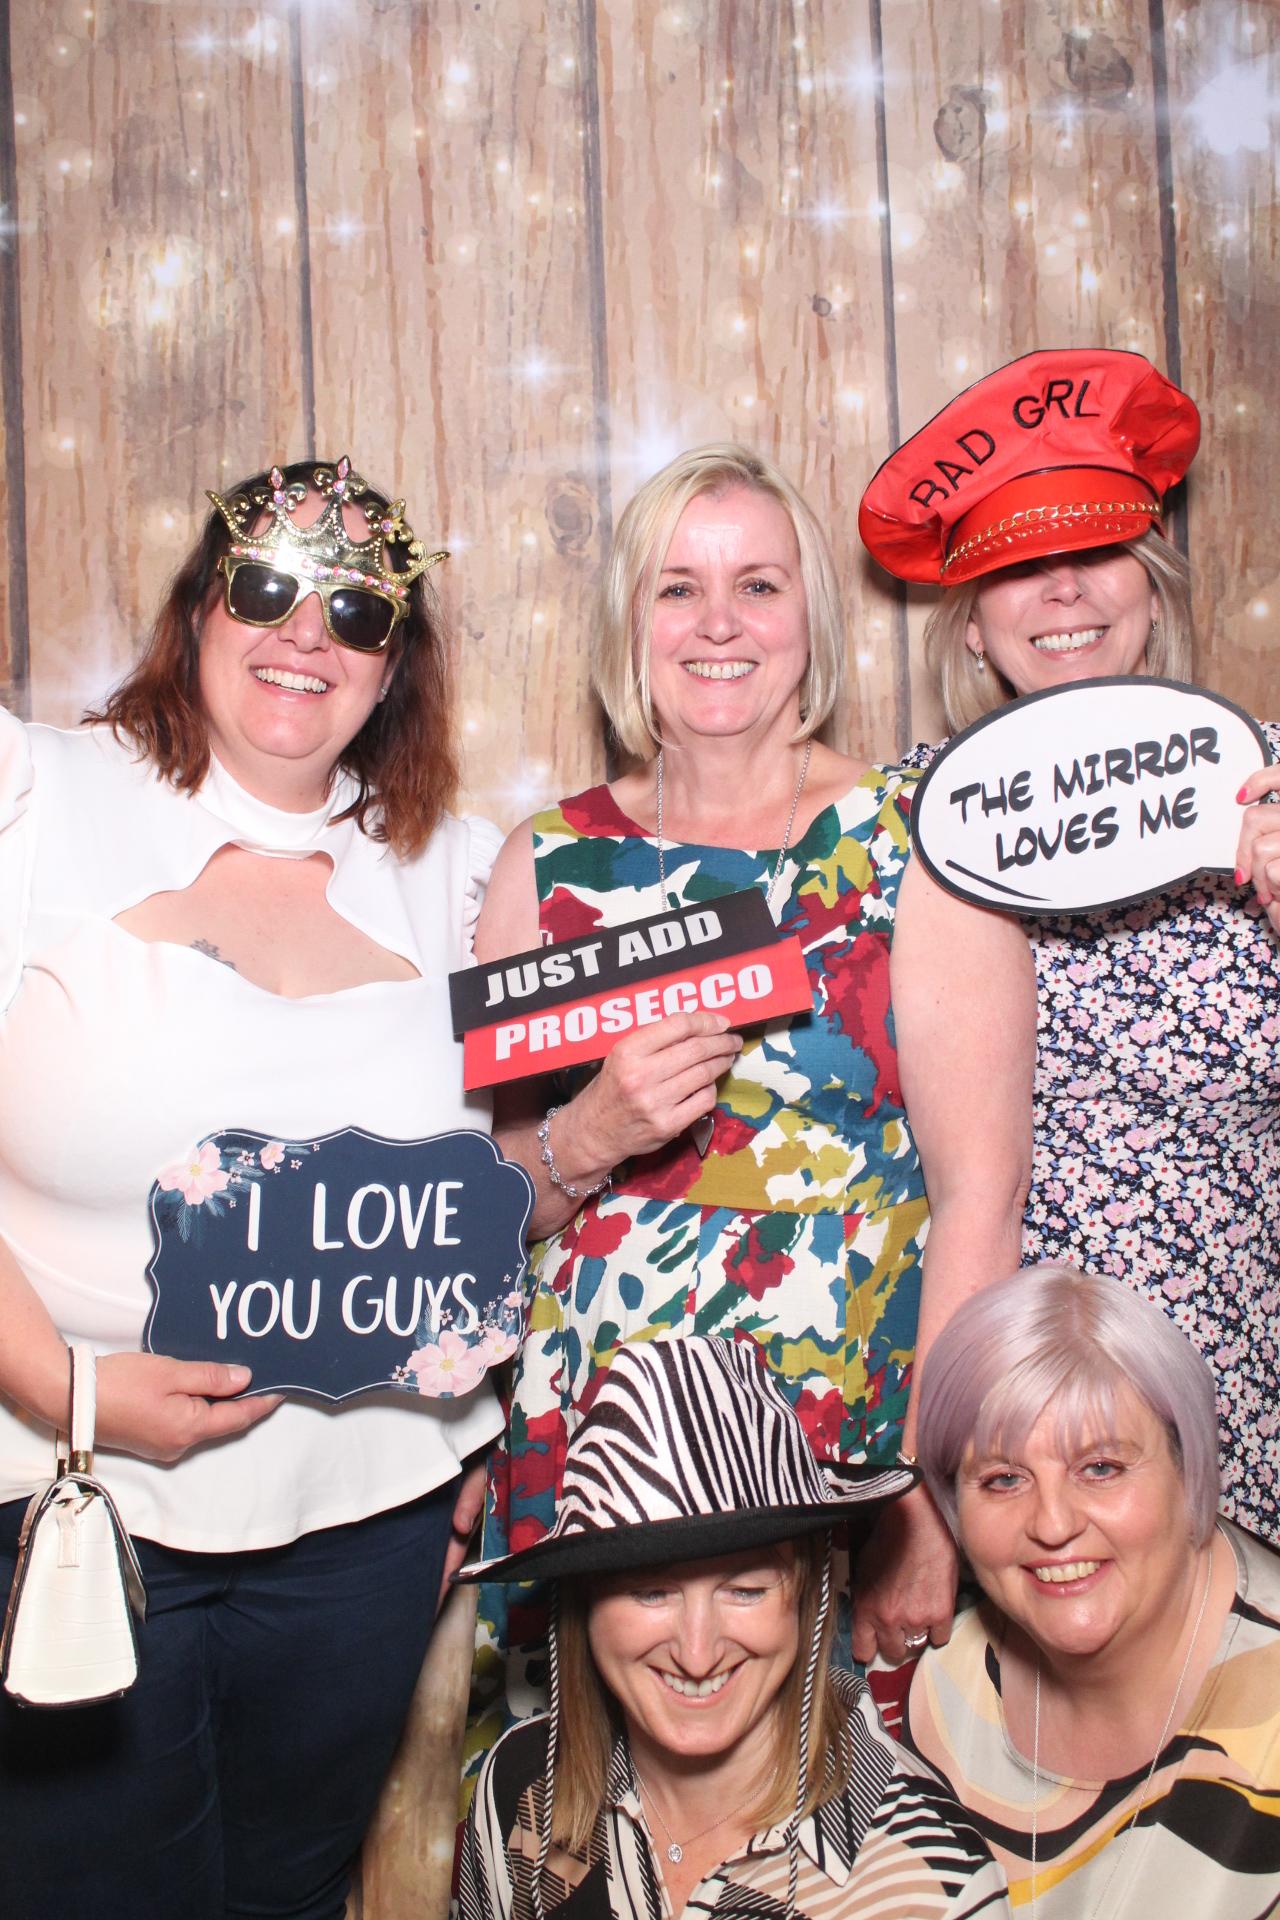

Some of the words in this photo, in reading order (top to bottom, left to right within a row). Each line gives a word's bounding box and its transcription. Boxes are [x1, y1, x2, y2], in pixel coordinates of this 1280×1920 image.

[909, 428, 997, 508] BAD
[1013, 379, 1101, 429] GRL
[950, 770, 1034, 824] THE
[1054, 726, 1221, 803] MIRROR
[996, 806, 1119, 871] LOVES
[1140, 787, 1198, 839] ME
[485, 942, 602, 1008] JUST
[618, 910, 723, 968] ADD
[495, 964, 773, 1061] PROSECCO
[247, 1183, 261, 1252] I
[312, 1181, 464, 1250] LOVE
[209, 1277, 321, 1340] YOU
[341, 1273, 479, 1337] GUYS
